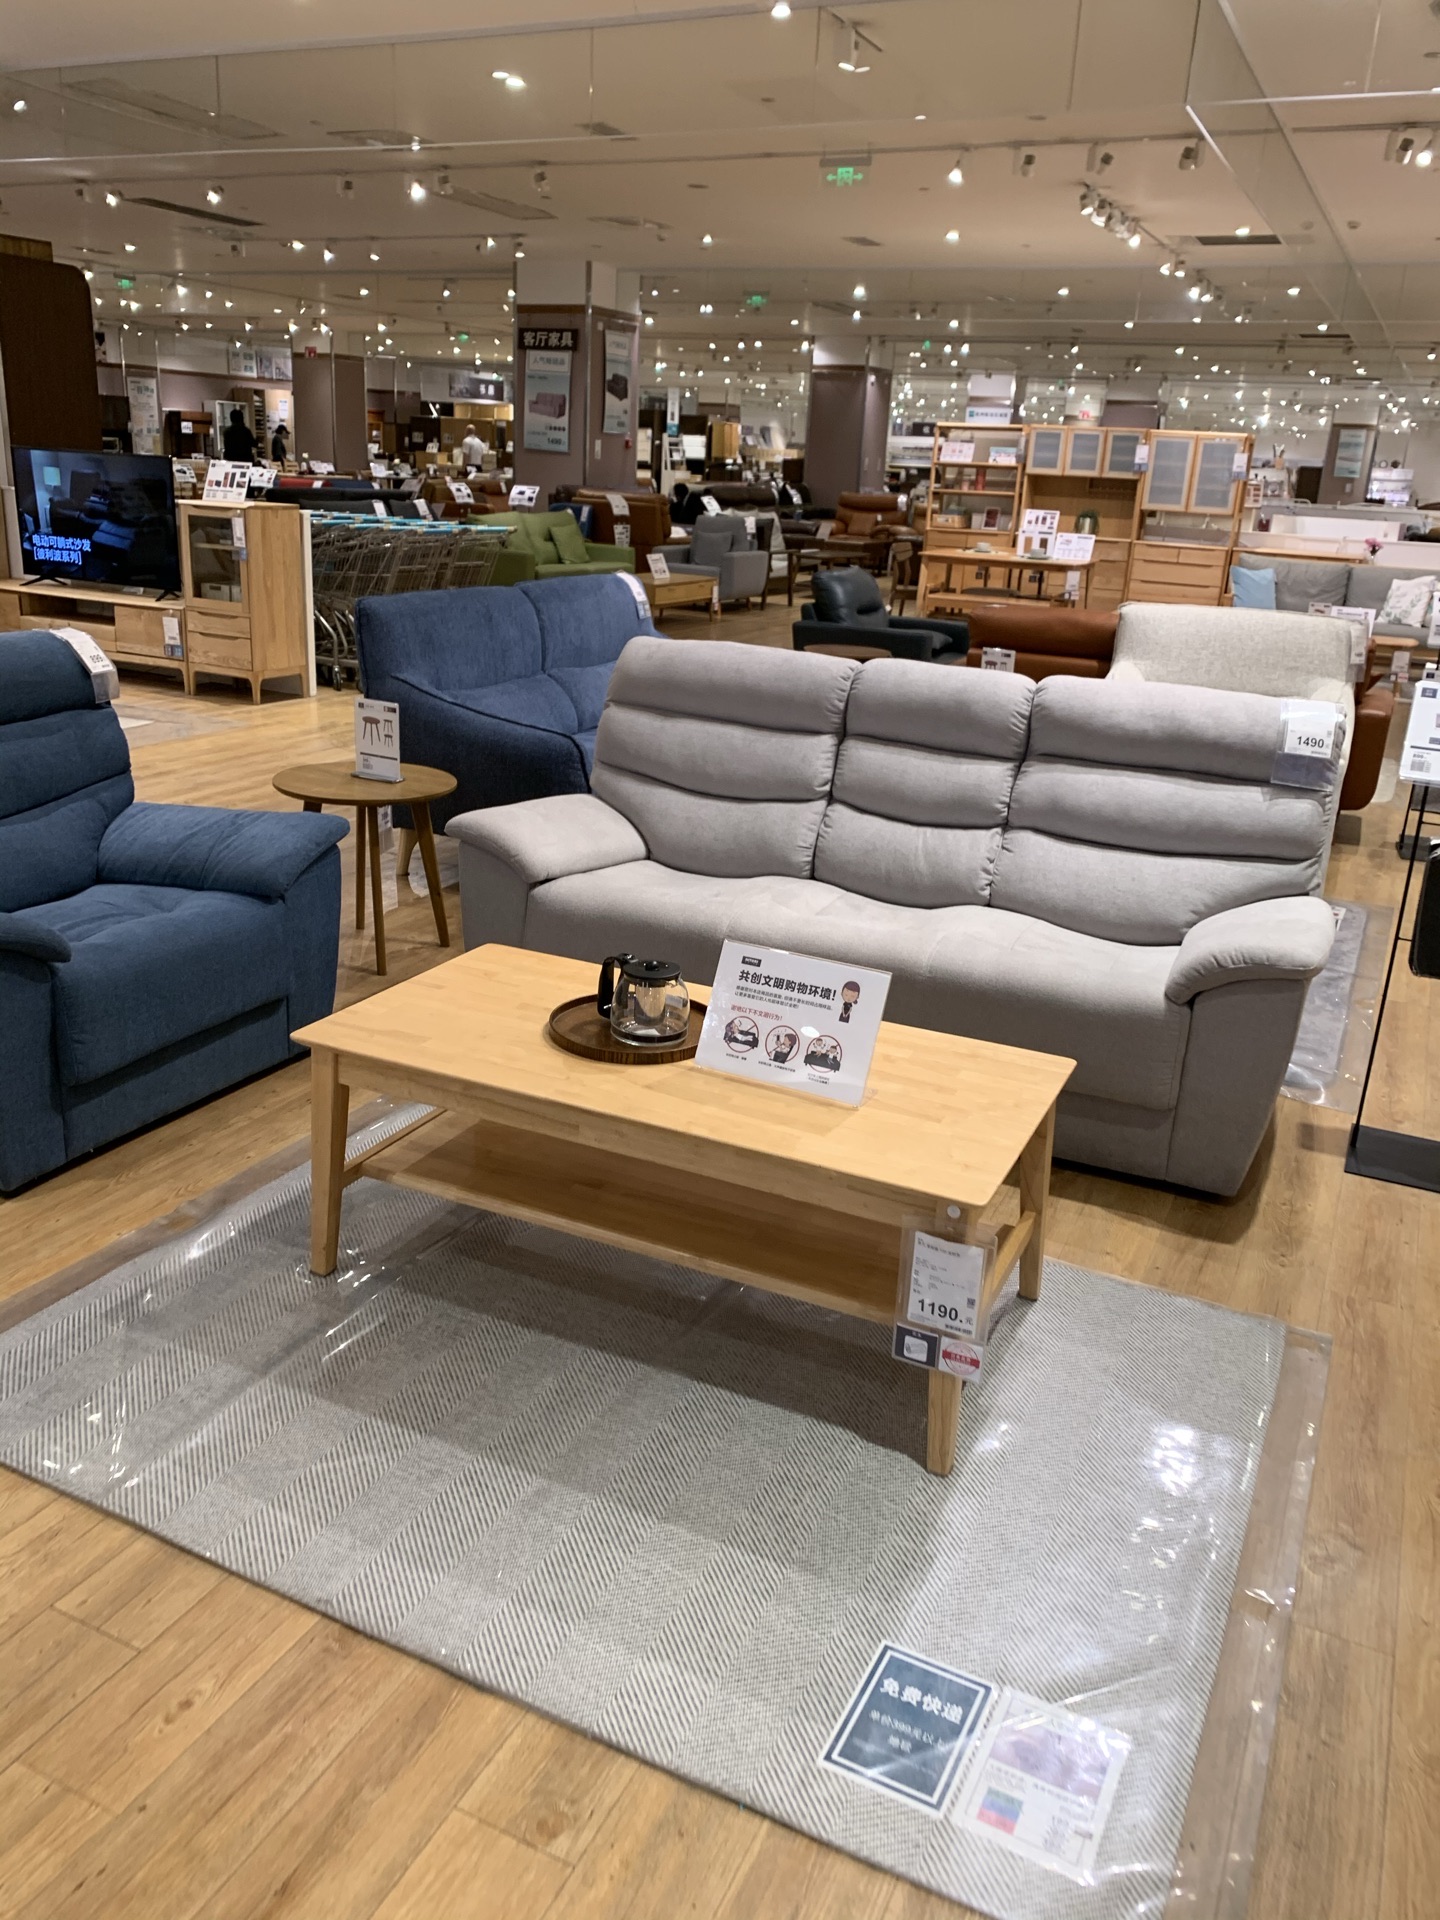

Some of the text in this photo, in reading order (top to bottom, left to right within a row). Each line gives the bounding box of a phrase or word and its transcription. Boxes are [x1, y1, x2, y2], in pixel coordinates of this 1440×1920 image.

[523, 331, 574, 347] 客厅家具
[32, 534, 91, 552] 电动可躺式沙发
[1297, 736, 1325, 749] 1490
[880, 1677, 963, 1725] 免费快递
